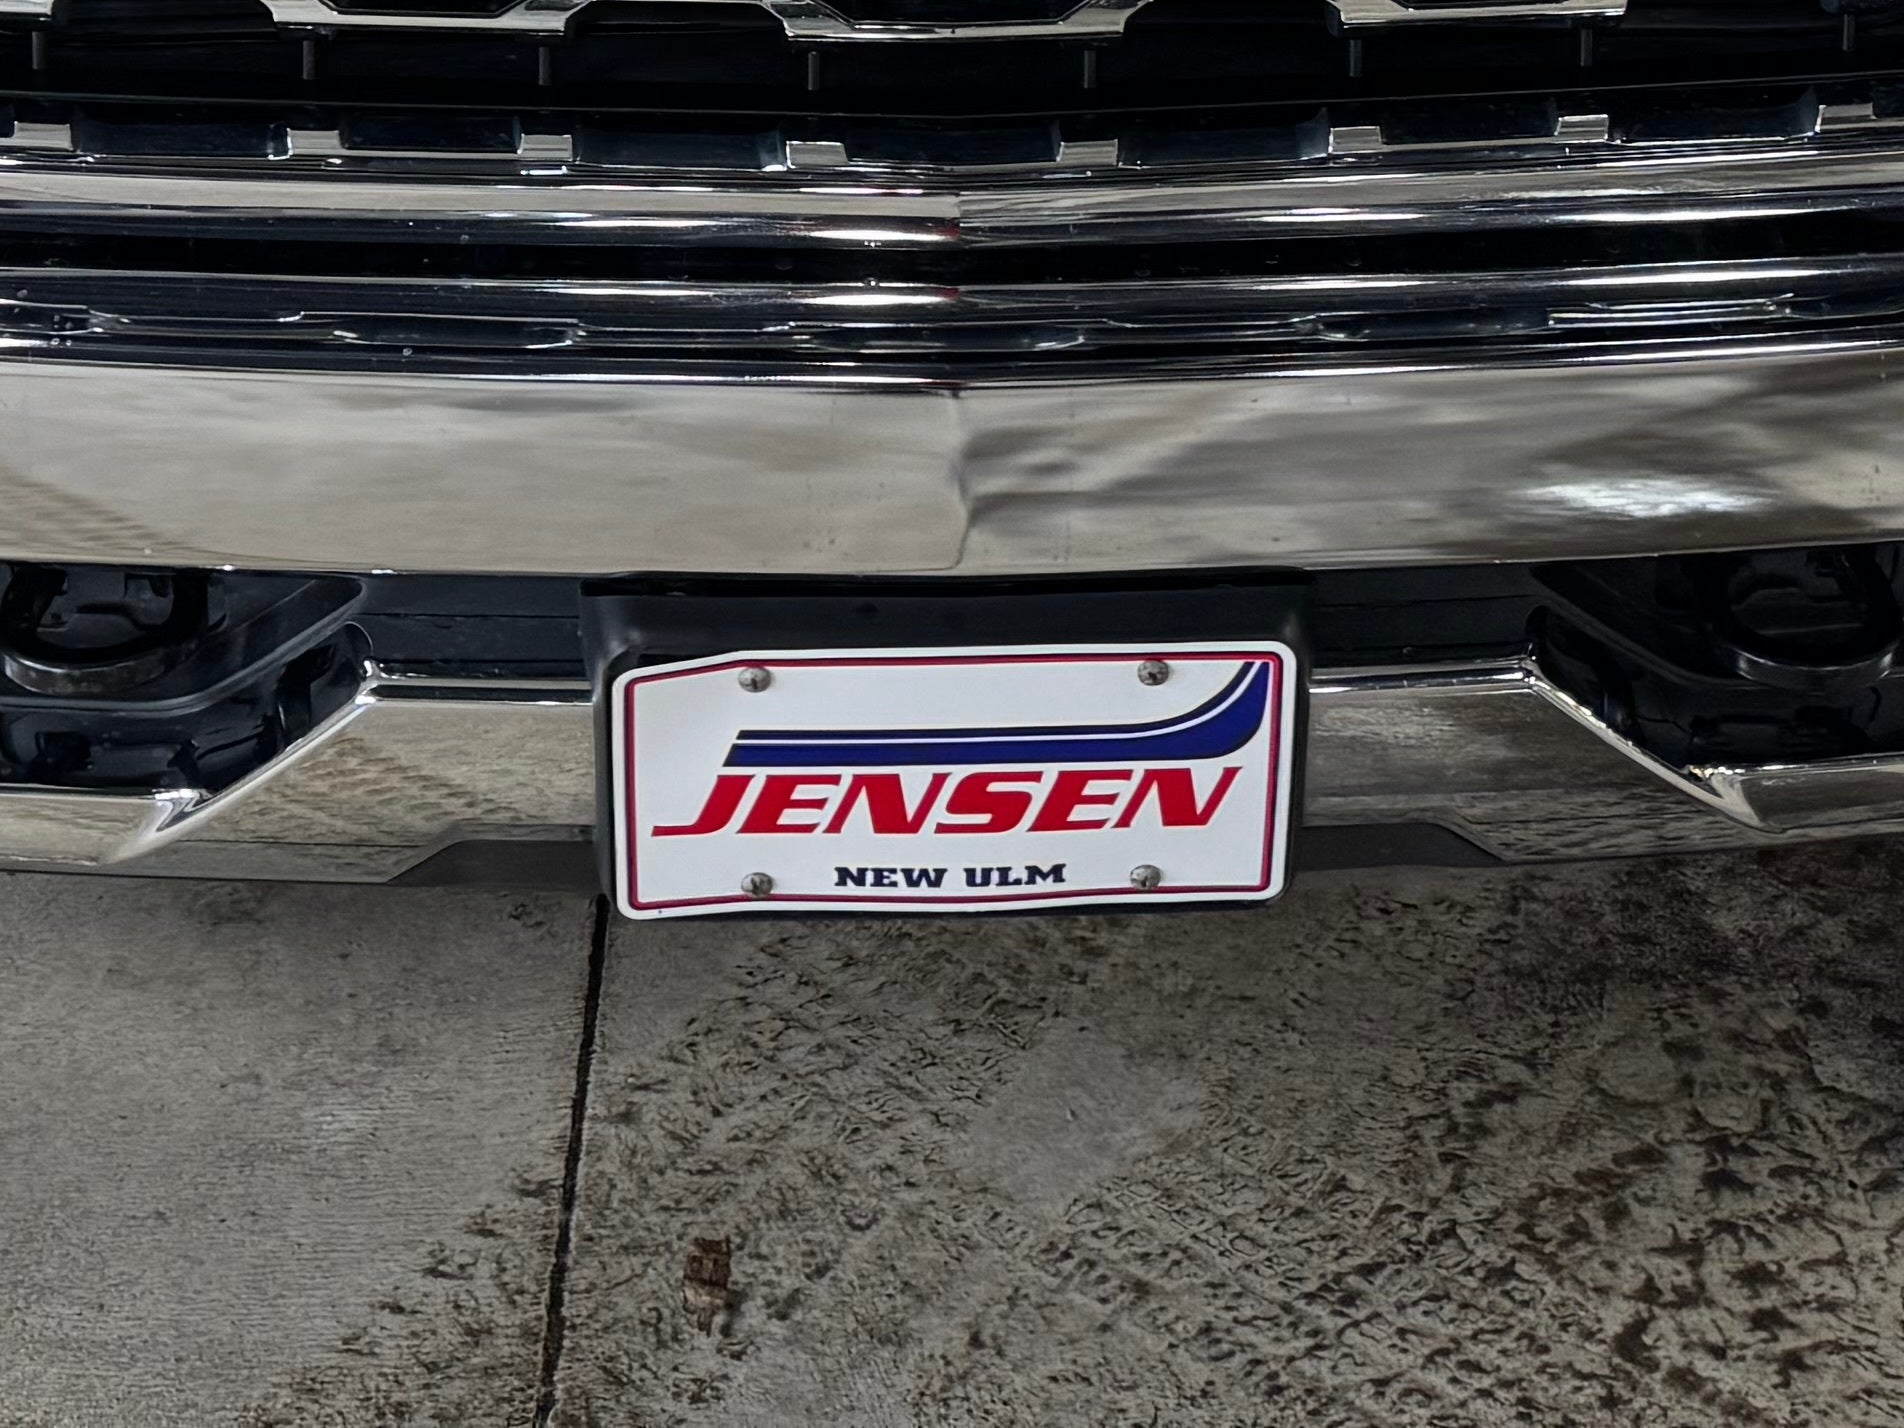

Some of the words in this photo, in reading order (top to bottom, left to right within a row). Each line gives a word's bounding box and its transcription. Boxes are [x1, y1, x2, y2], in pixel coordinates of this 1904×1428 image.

[651, 766, 1244, 837] JENSEN
[834, 866, 949, 888] NEW
[963, 863, 1067, 887] ULM
